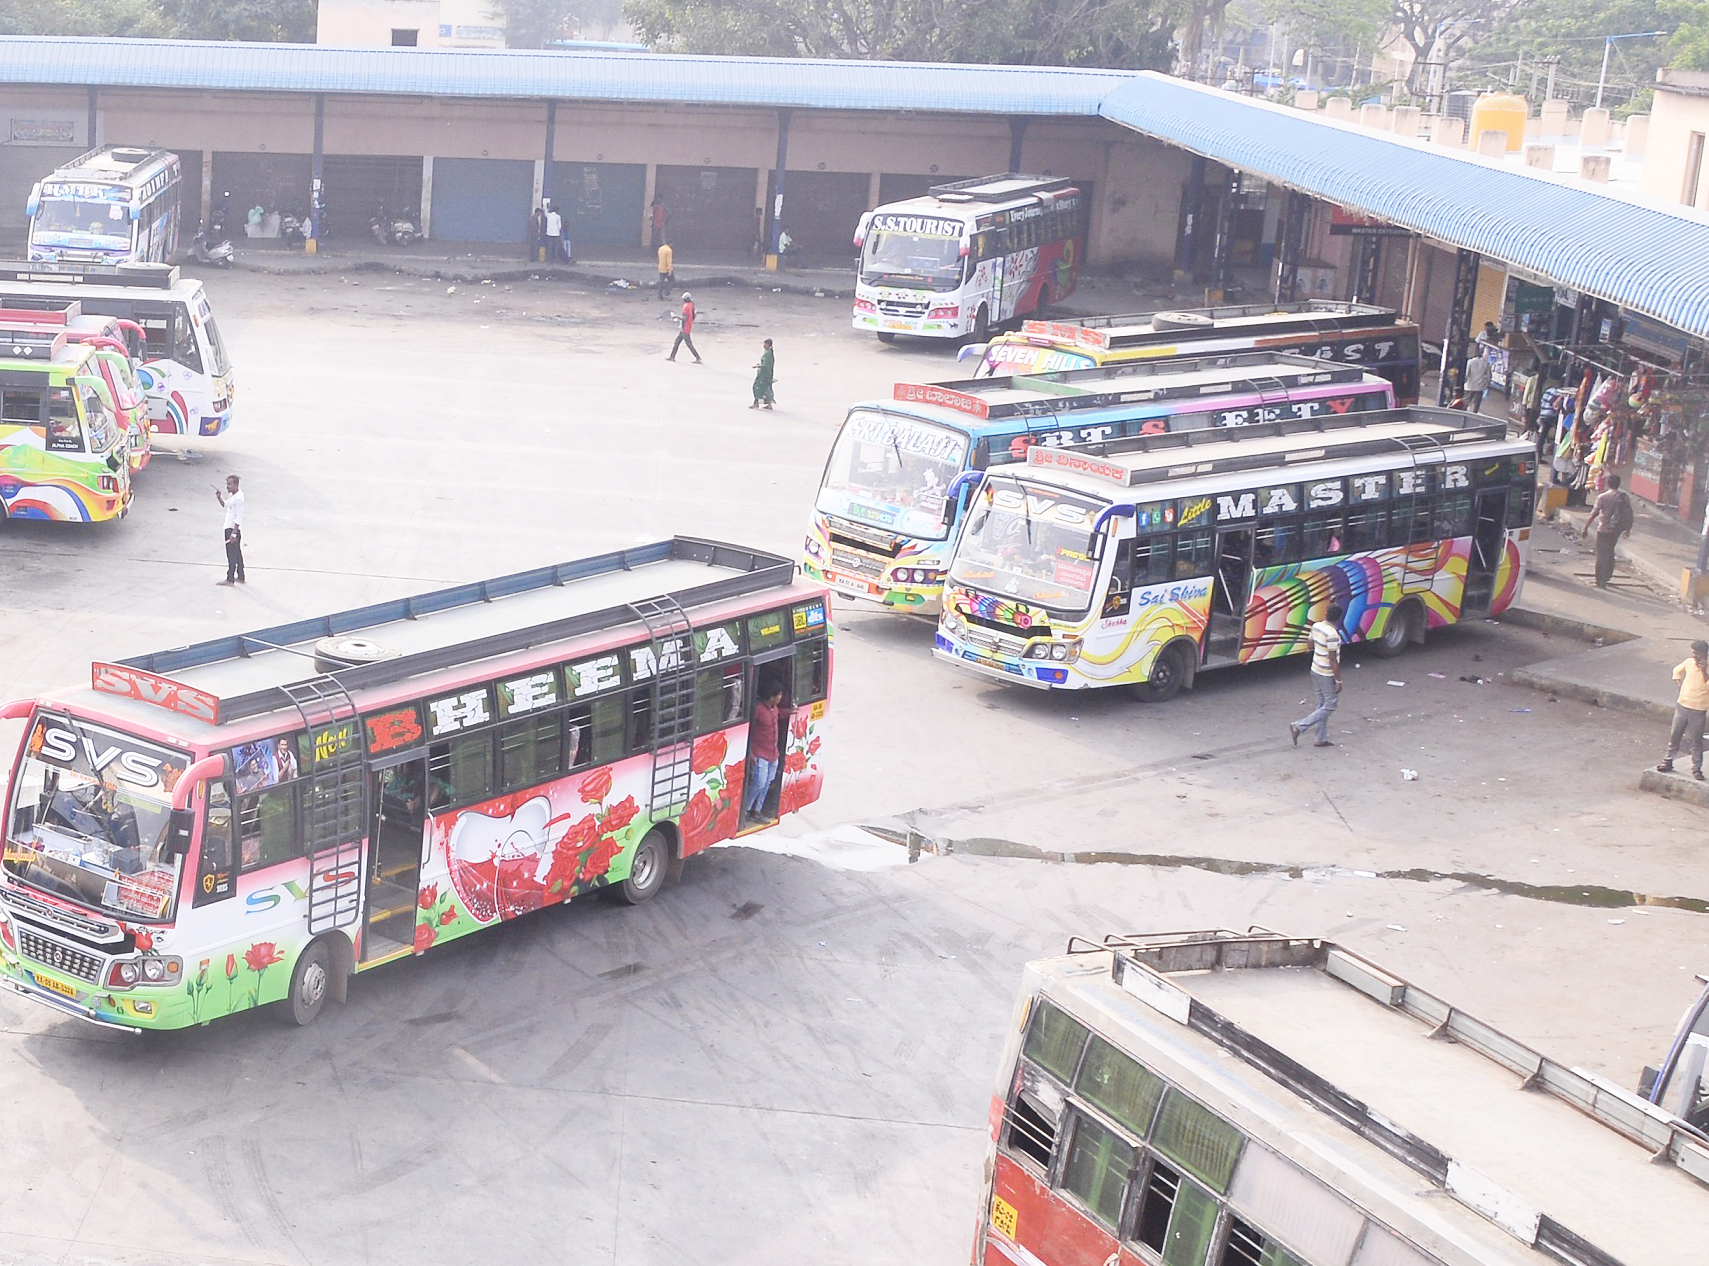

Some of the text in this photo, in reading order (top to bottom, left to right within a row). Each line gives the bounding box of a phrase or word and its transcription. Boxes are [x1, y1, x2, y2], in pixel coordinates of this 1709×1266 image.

[988, 345, 1091, 371] SEVEN HILLS
[849, 418, 959, 461] SRI BALAJI
[994, 489, 1087, 524] SVS
[1217, 465, 1469, 520] MASTER
[1138, 582, 1209, 607] Sai Shiva
[94, 667, 216, 722] SVS
[366, 628, 740, 754] BHEEMA
[41, 727, 162, 788] SVS
[245, 864, 357, 915] SVS
